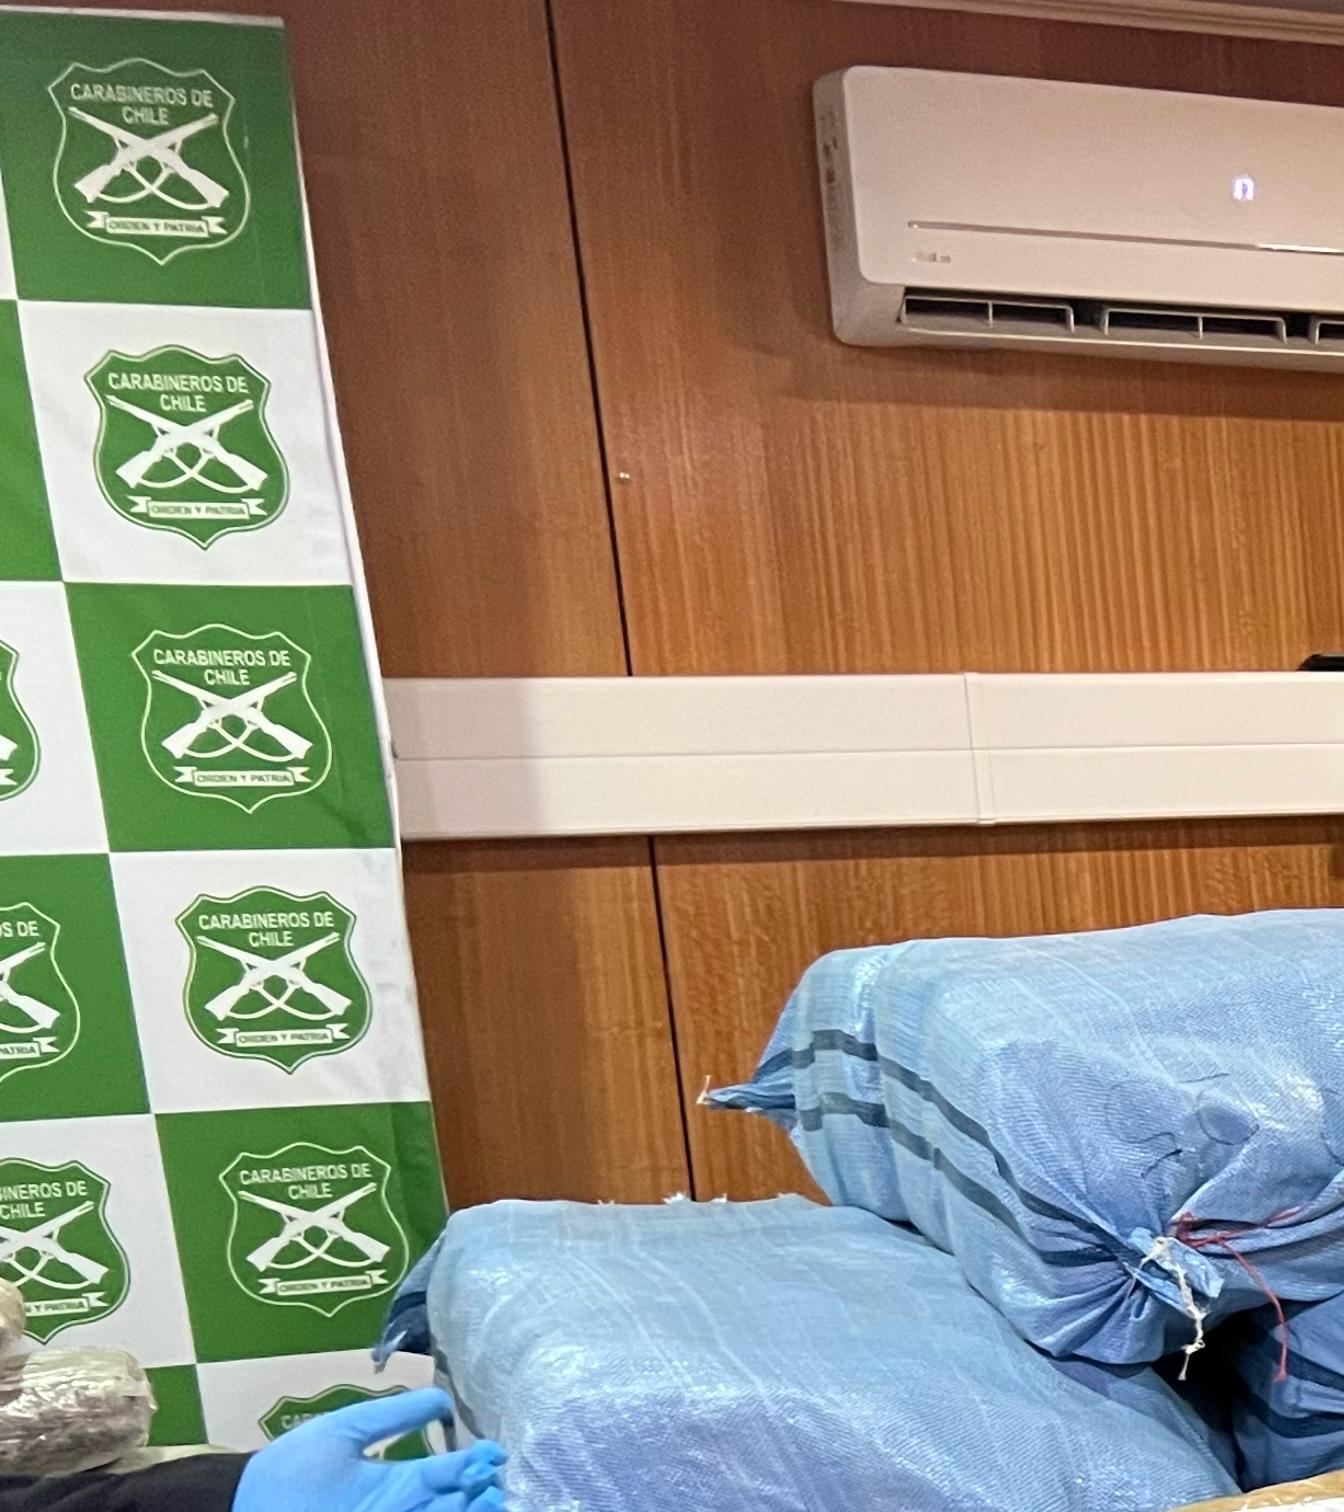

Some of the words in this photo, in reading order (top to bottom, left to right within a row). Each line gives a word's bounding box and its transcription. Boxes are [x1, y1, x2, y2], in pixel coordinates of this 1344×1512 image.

[70, 83, 187, 105] CARABINEROS
[191, 89, 213, 108] DE
[122, 106, 169, 125] CHILE
[108, 372, 223, 393] CARABINEROS
[226, 376, 249, 393] DE
[160, 394, 206, 412] CHILE
[153, 649, 265, 666] CARABINEROS
[269, 650, 291, 667] DE
[204, 669, 250, 686] CHILE
[17, 921, 40, 937] DE
[199, 912, 310, 930] CARABINEROS
[314, 911, 335, 928] DE
[248, 931, 294, 947] CHILE
[240, 1163, 348, 1185] CARABINEROS
[351, 1163, 373, 1178] DE
[0, 1182, 62, 1201] INEROS
[66, 1180, 88, 1197] DE
[288, 1182, 333, 1200] CHILE
[0, 1201, 46, 1219] CHILE
